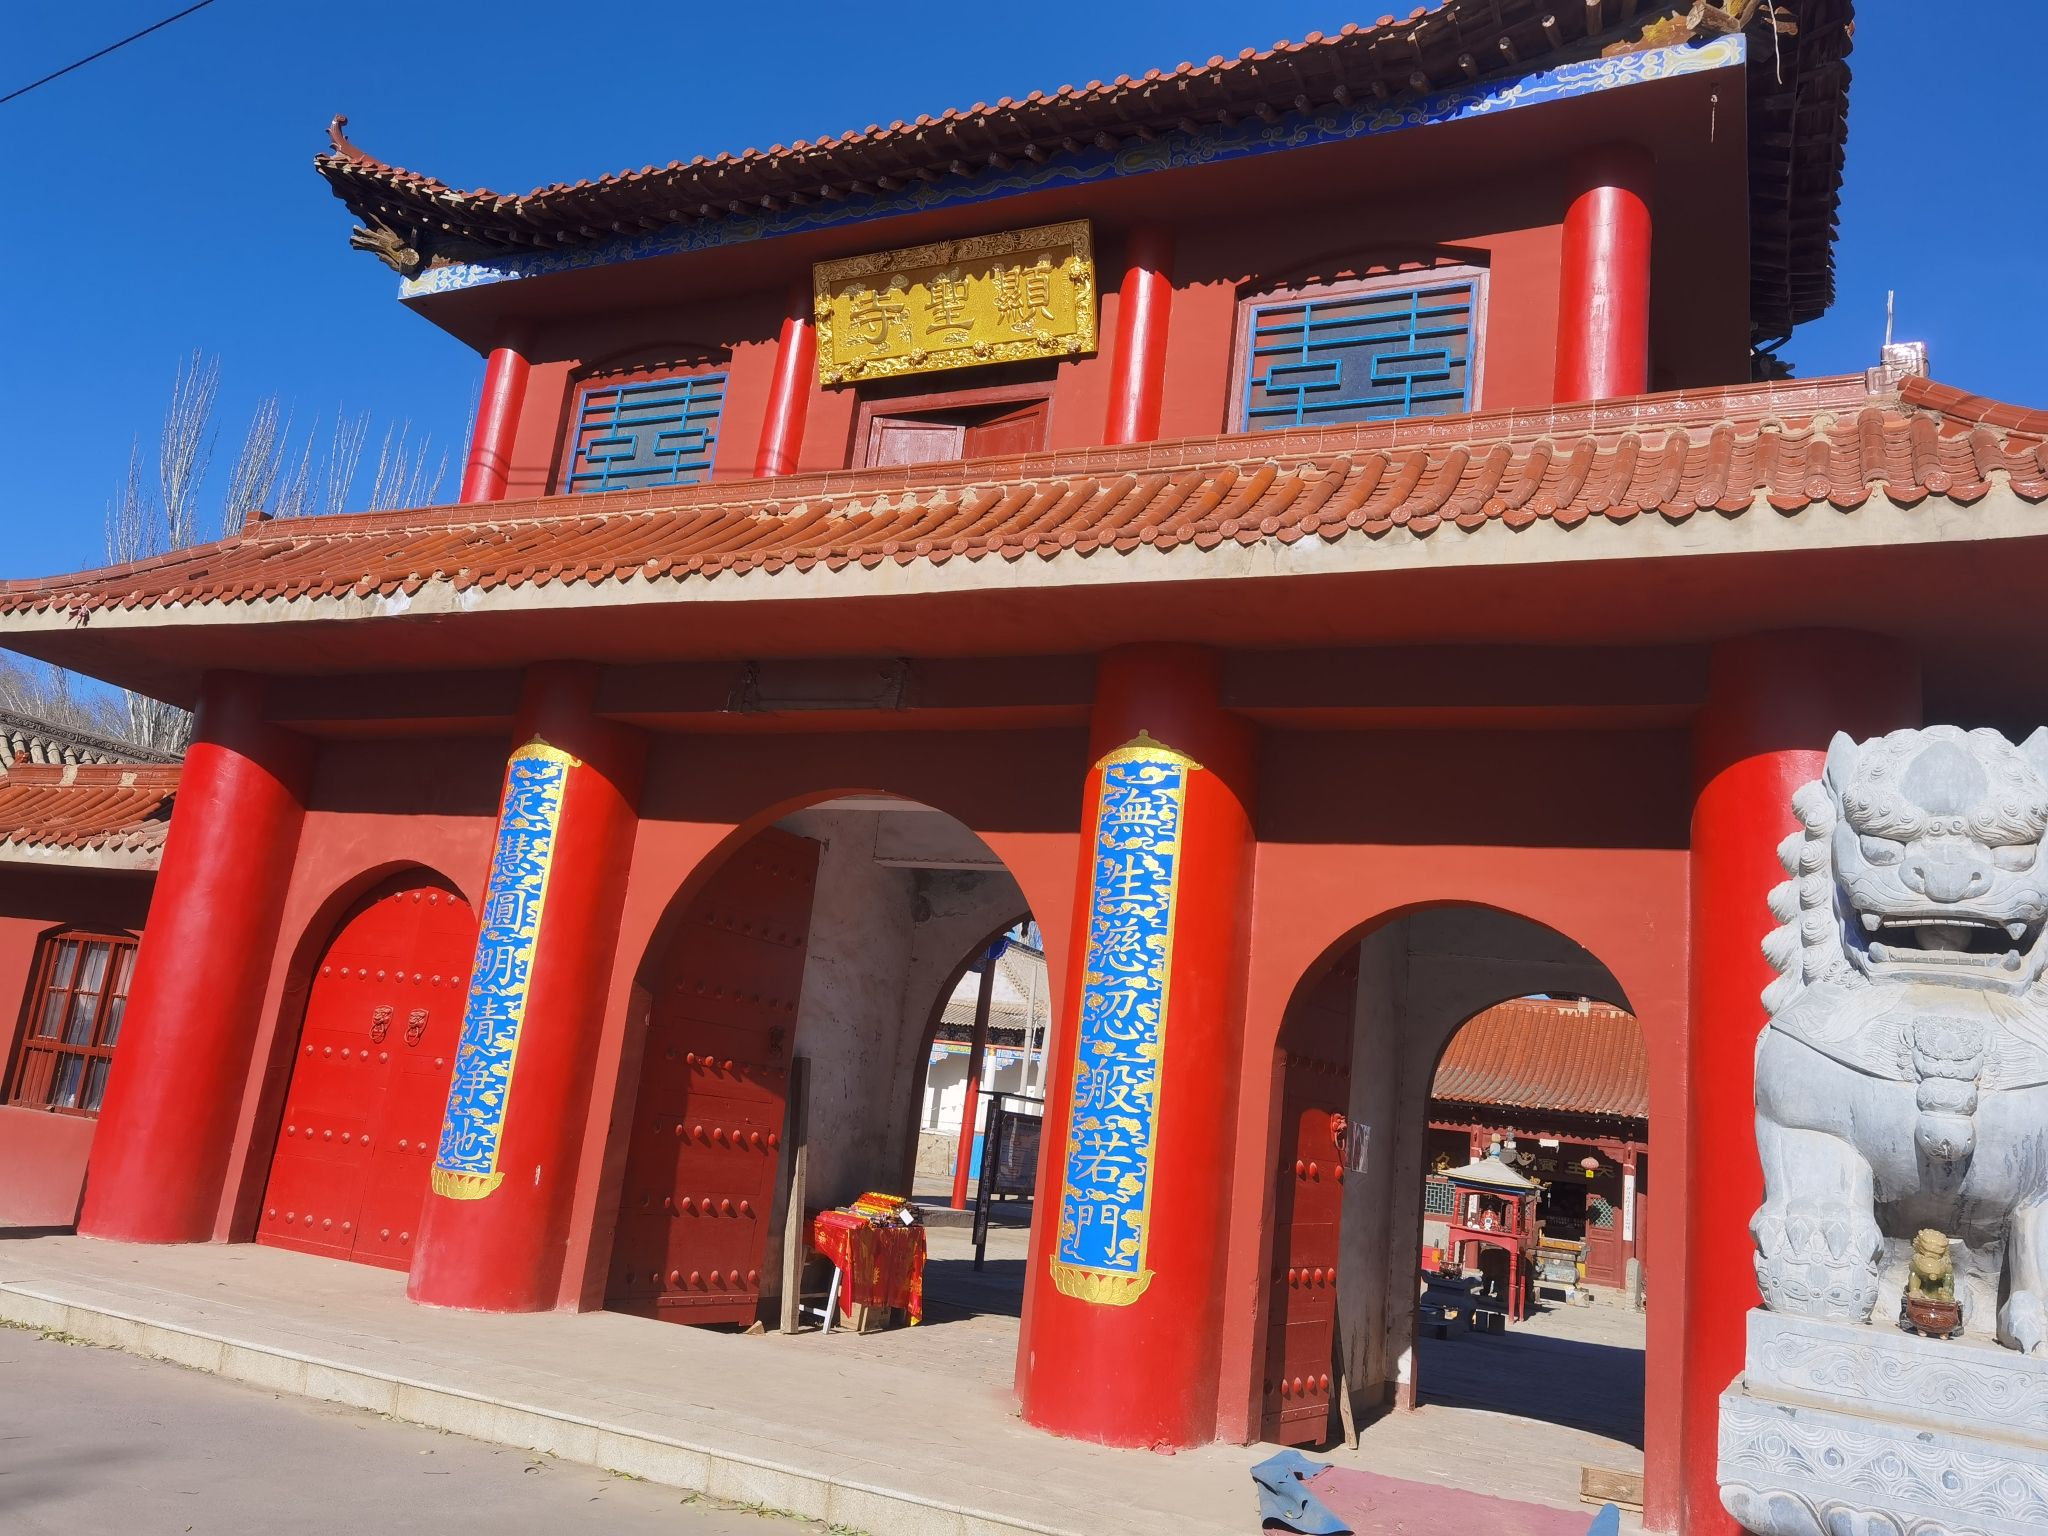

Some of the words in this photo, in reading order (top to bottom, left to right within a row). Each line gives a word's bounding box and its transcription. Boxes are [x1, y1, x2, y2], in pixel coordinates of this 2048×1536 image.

[1074, 787, 1162, 1257] 無生慈忍般若門
